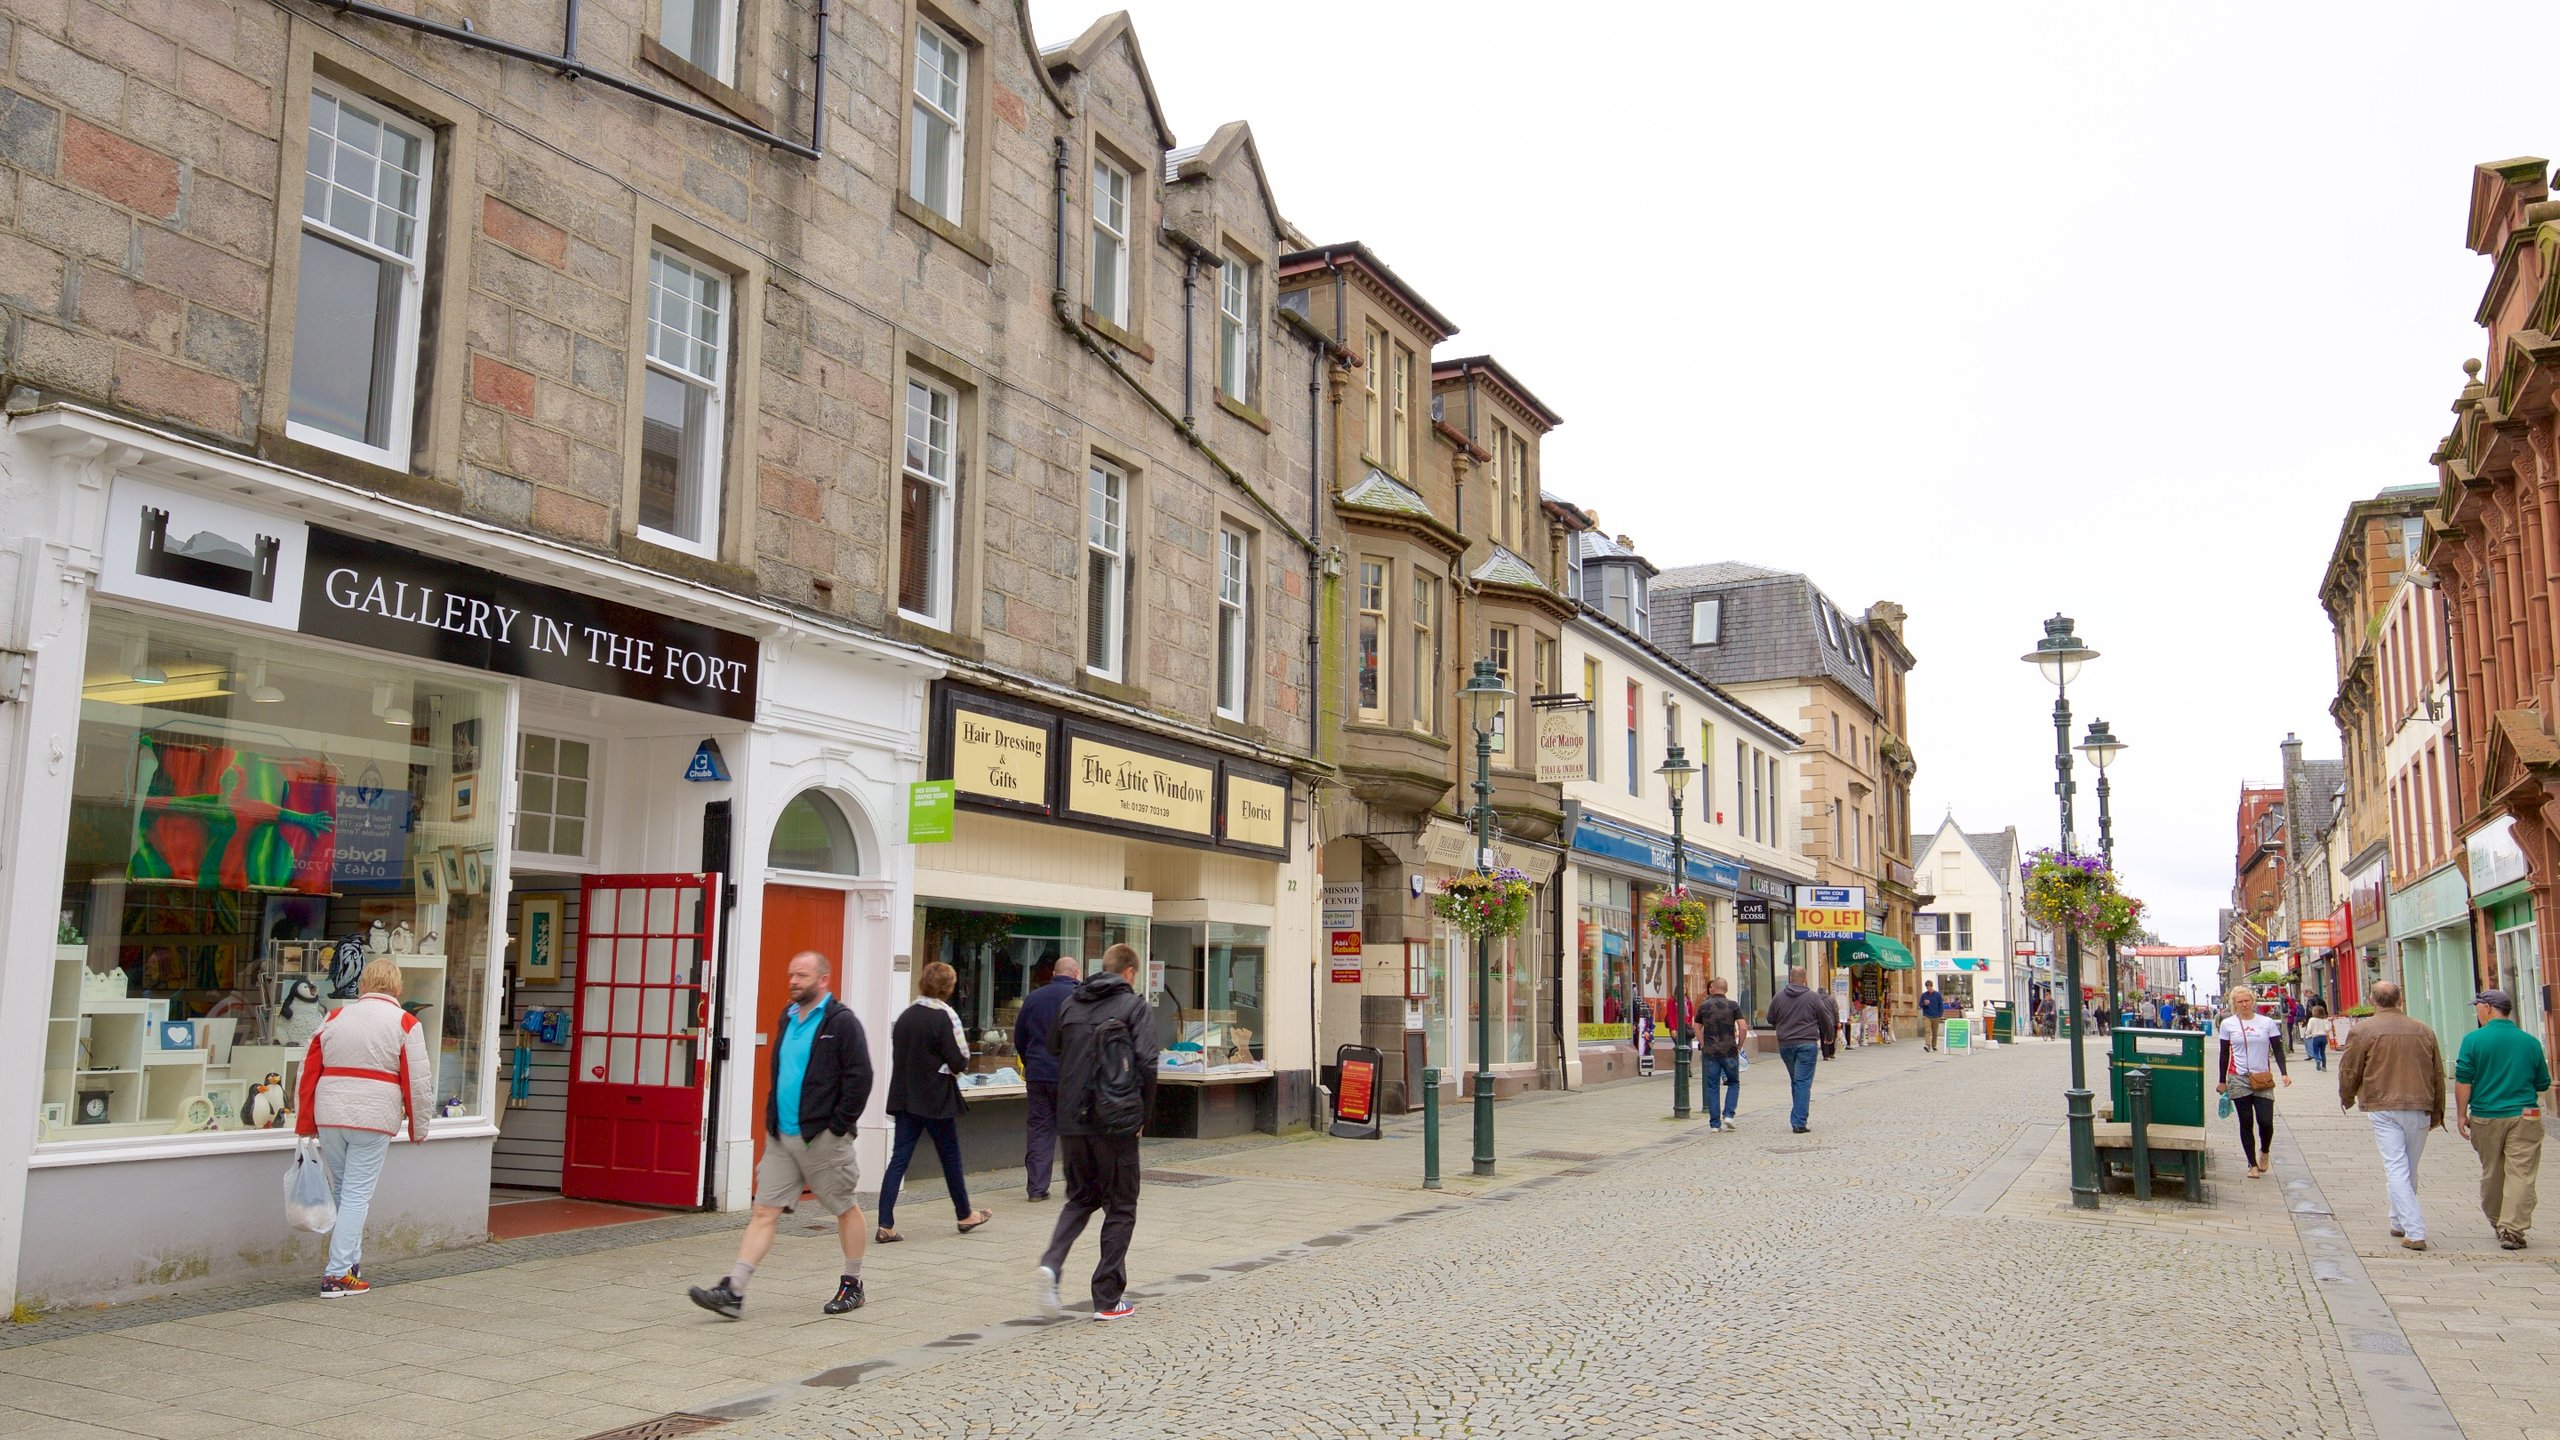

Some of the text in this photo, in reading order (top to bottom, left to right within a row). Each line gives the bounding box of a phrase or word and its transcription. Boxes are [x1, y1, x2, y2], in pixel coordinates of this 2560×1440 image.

[325, 568, 748, 694] GALLERY IN THE FORT
[963, 721, 1042, 758] Hair Dressing
[1541, 735, 1584, 748] Café Mango
[999, 754, 1006, 765] &
[689, 770, 713, 778] Chubb
[1541, 766, 1555, 775] THAI
[1562, 764, 1584, 773] INDIAN
[988, 767, 1017, 789] Gifts
[1082, 753, 1205, 803] The Attic Window
[1120, 800, 1170, 818] Tel: 01397 703139
[1242, 800, 1272, 821] Florist
[1287, 880, 1297, 892] 22
[1324, 886, 1360, 894] MISSION
[1757, 878, 1769, 895] CAFÉ
[1325, 897, 1360, 905] CENTRE
[1743, 904, 1763, 913] CAFÉ
[1800, 909, 1860, 926] TO LET
[1852, 952, 1869, 960] Gifts
[2146, 1056, 2168, 1064] Litter
